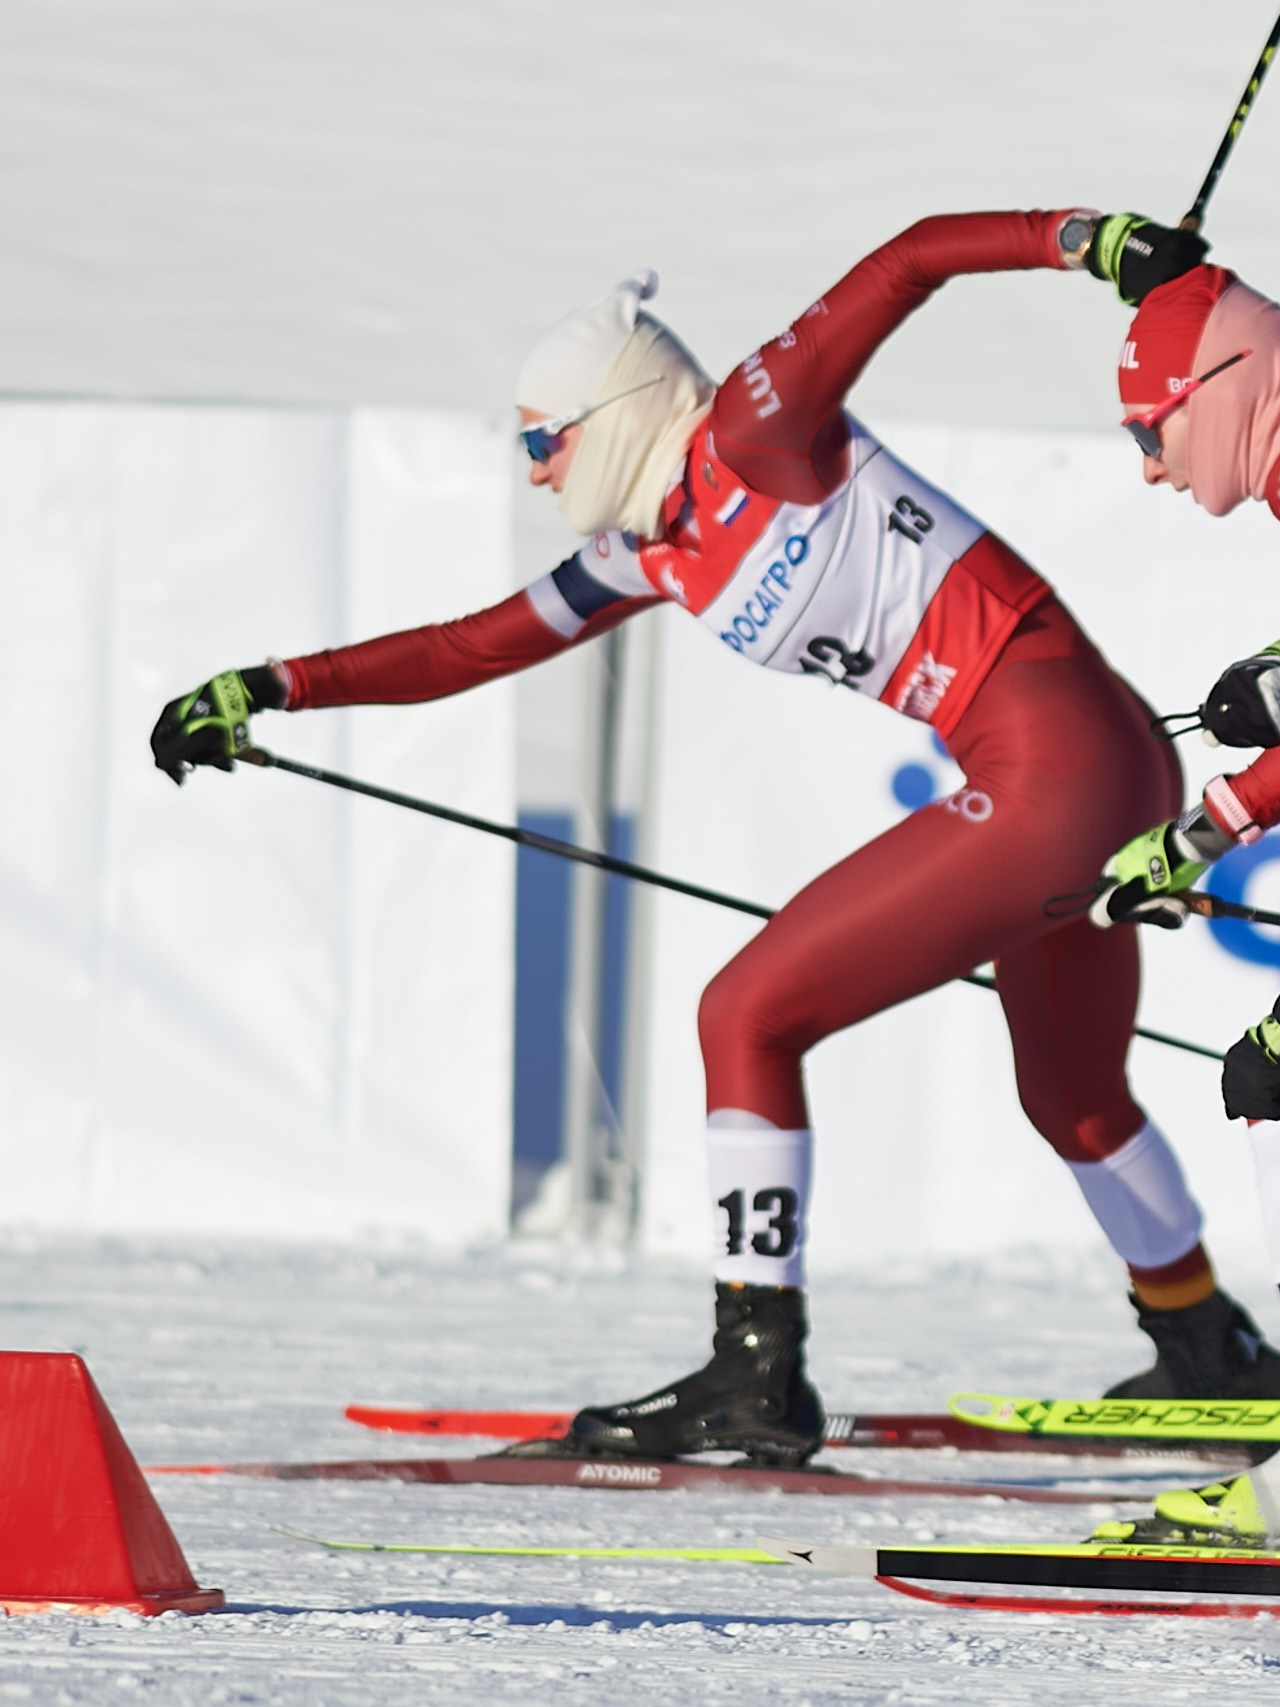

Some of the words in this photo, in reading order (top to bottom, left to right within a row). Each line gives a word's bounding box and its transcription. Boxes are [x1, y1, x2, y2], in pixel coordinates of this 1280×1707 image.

[1119, 340, 1140, 368] IL
[886, 494, 936, 546] 13
[717, 1186, 800, 1258] 13
[578, 1463, 662, 1484] ATOMIC
